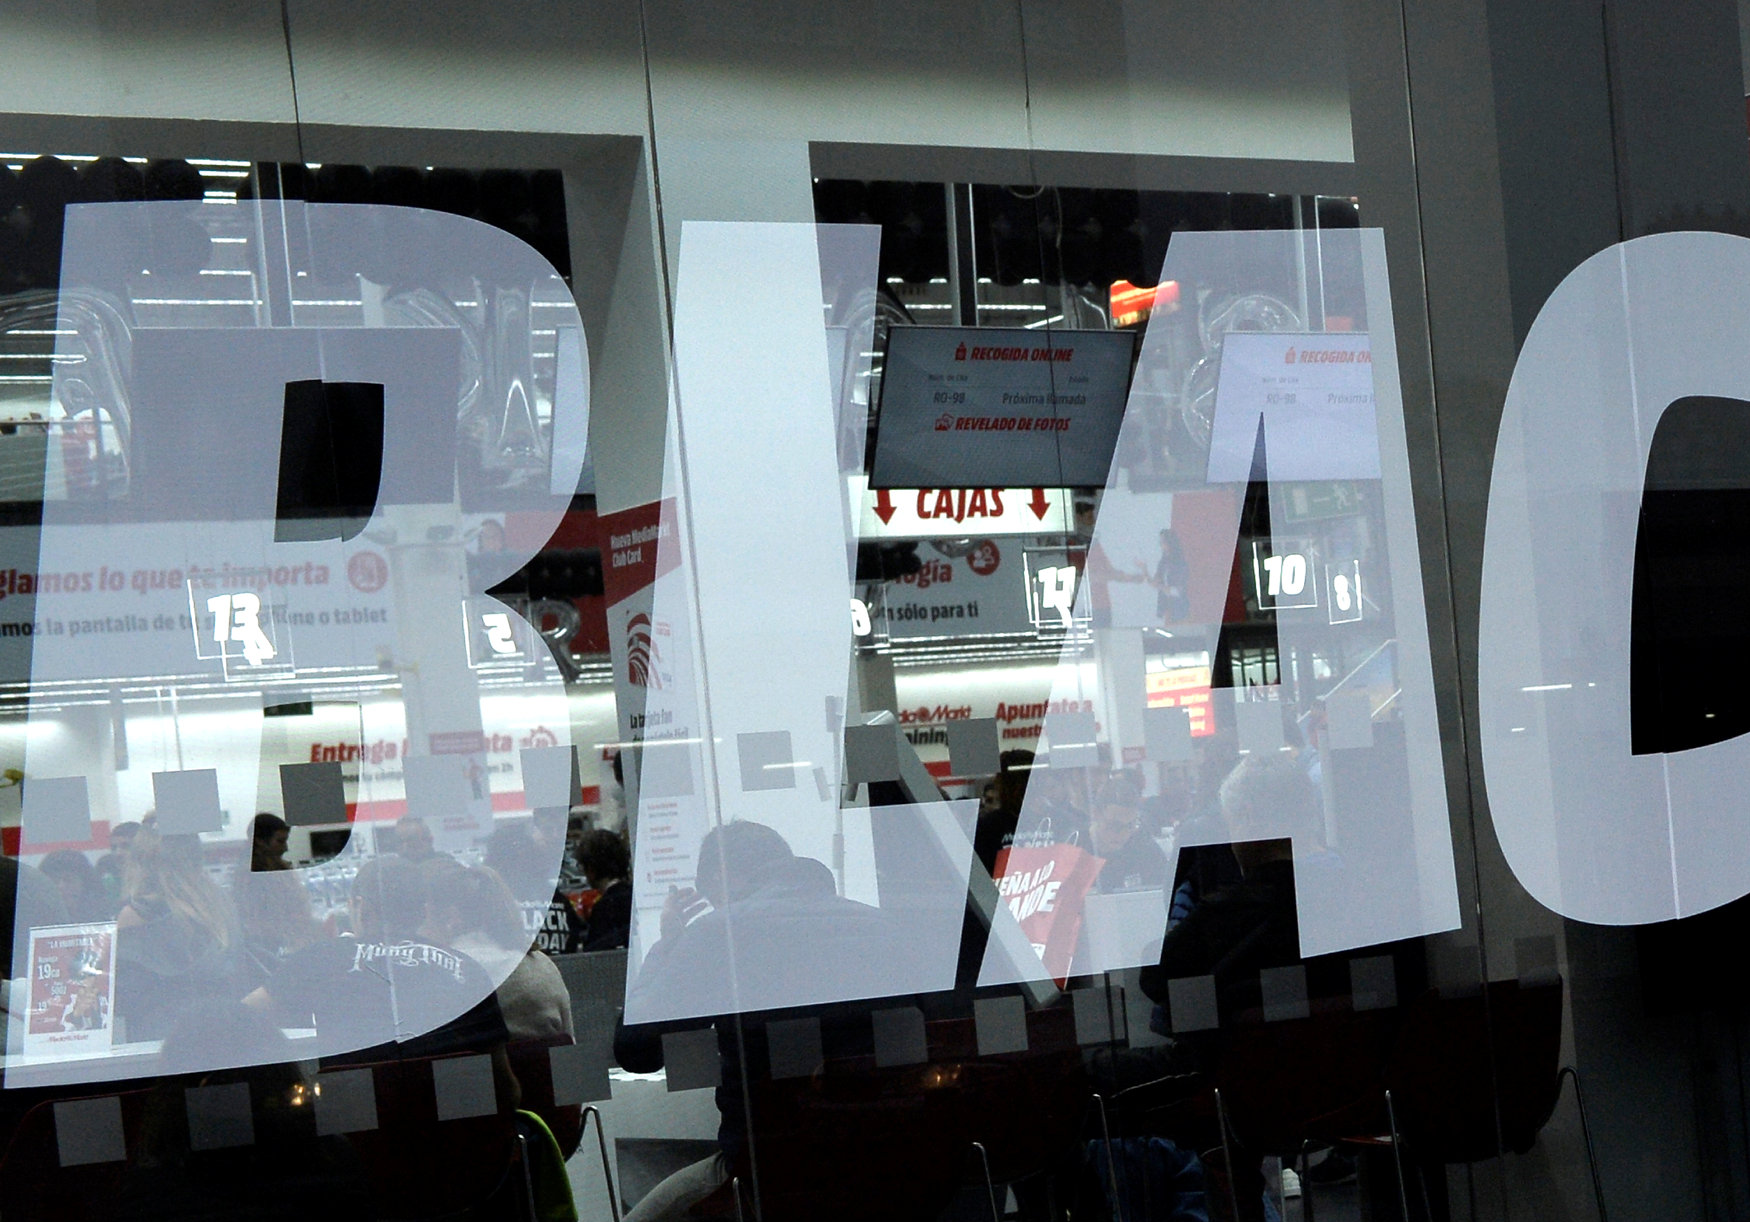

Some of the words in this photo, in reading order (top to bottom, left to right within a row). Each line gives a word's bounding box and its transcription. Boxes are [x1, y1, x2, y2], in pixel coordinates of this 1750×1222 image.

[970, 347, 1029, 361] RECOGIDA
[1031, 347, 1075, 362] ONLINE
[1300, 350, 1355, 364] RECOGIDA
[1002, 391, 1045, 406] Próxima
[954, 416, 1015, 432] REVELADO
[1016, 417, 1032, 431] DE
[1033, 417, 1071, 432] FOTOS
[916, 488, 1004, 524] CAJAS
[99, 564, 127, 592] lo
[130, 567, 184, 598] que
[1263, 554, 1306, 596] 10
[0, 621, 42, 638] mos
[45, 615, 64, 636] la
[68, 613, 148, 638] pantalla
[153, 611, 176, 632] de
[334, 605, 388, 627] tablet
[207, 592, 261, 642] 13
[896, 602, 928, 621] sólo
[931, 605, 960, 622] para
[961, 600, 979, 619] ti
[311, 738, 397, 764] Entrega
[521, 909, 570, 932] LACK
